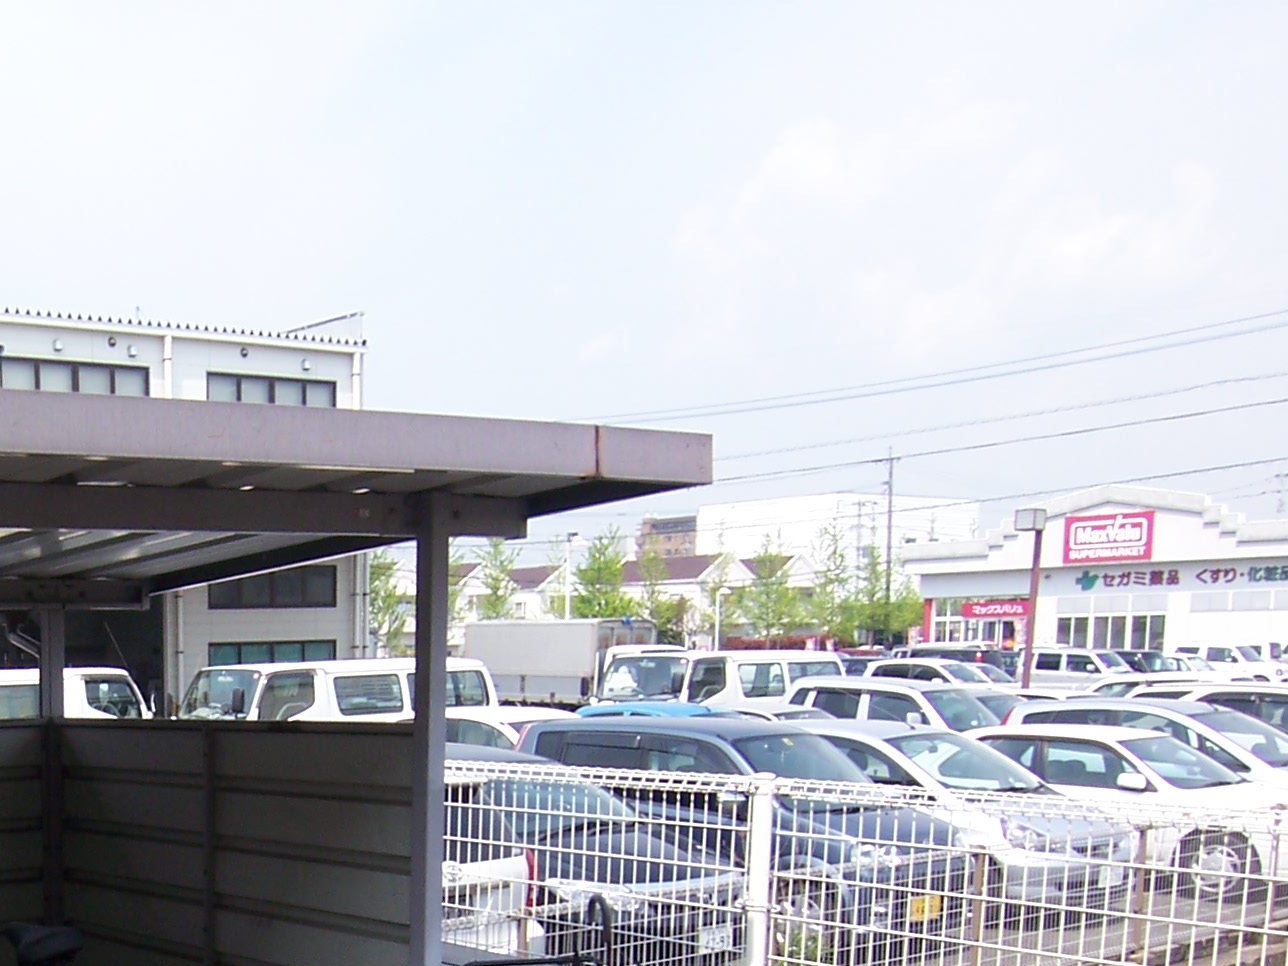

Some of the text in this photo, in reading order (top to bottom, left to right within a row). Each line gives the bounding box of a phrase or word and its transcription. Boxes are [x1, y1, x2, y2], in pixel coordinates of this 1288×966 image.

[1075, 514, 1142, 545] MaxValu
[1068, 546, 1146, 560] SUPERMARKET
[1102, 569, 1180, 587] セガミ薬品
